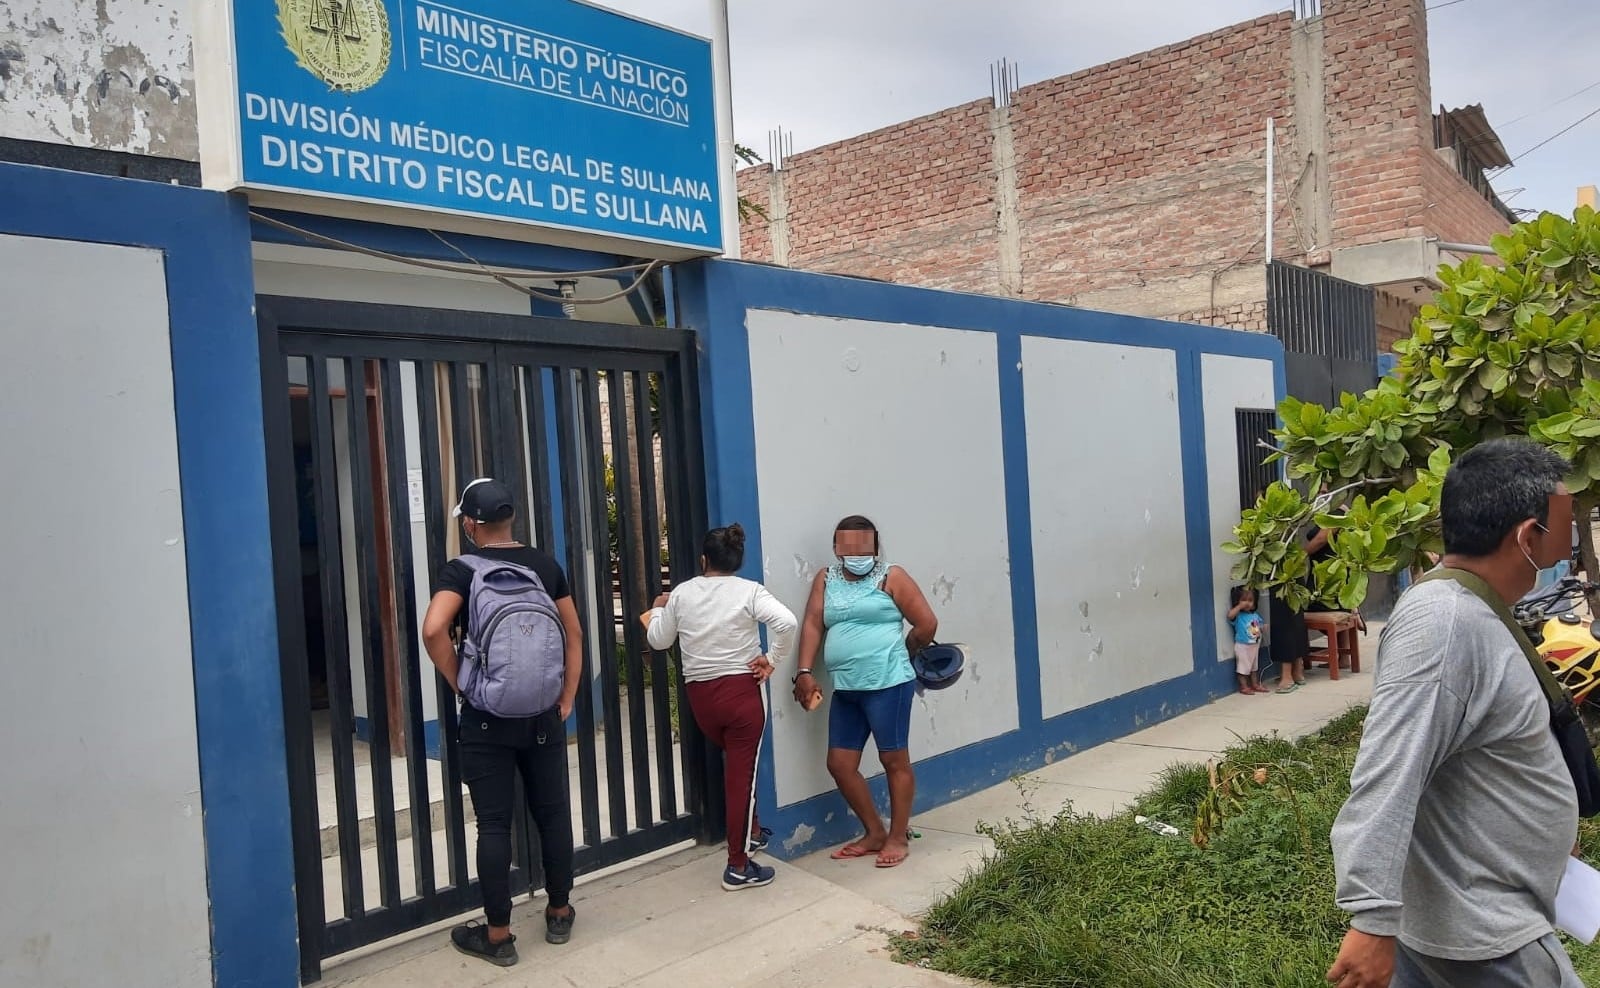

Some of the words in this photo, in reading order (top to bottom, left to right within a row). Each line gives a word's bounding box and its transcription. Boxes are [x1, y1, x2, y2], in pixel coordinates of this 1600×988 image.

[305, 48, 346, 79] MINISTERIO
[416, 5, 578, 69] MINISTERIO
[586, 52, 688, 97] PÚBLICO
[419, 37, 535, 86] FISCALÍA
[541, 68, 571, 94] DE
[579, 77, 606, 102] LA
[611, 85, 689, 123] NACIÓN
[245, 92, 381, 143] DIVISIÓN
[391, 121, 495, 162] MÉDICO
[502, 143, 580, 178] LEGAL
[585, 158, 615, 185] DE
[620, 166, 712, 203] SULLANA
[261, 134, 427, 190] DISTRITO
[437, 165, 544, 208] FISCAL
[551, 184, 588, 215] DE
[595, 192, 708, 234] SULLANA
